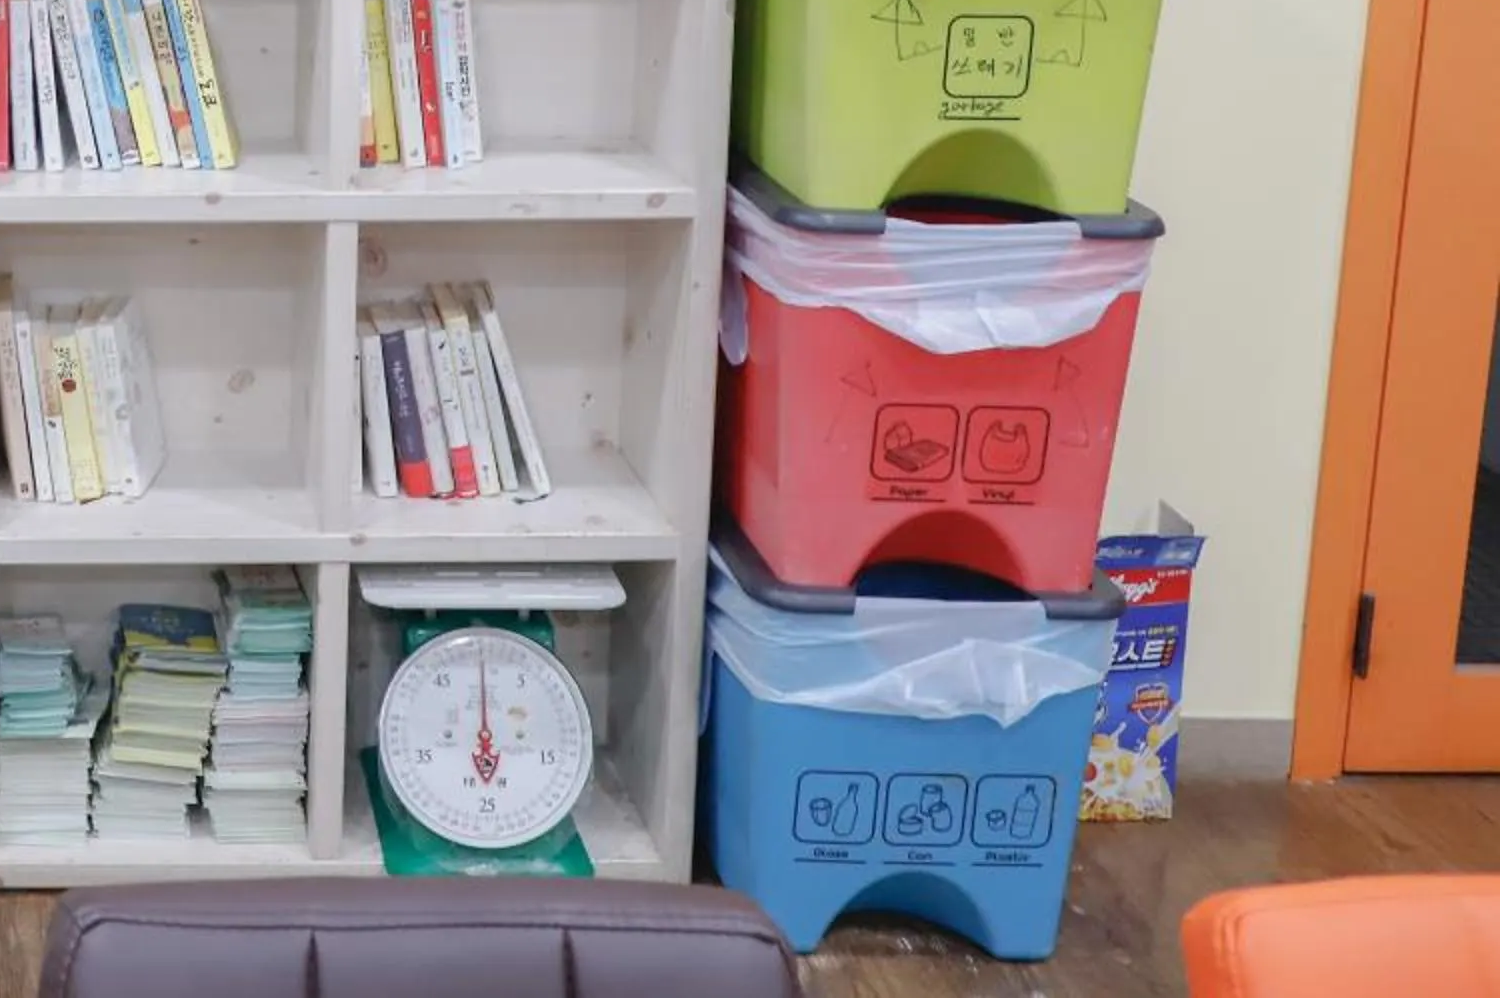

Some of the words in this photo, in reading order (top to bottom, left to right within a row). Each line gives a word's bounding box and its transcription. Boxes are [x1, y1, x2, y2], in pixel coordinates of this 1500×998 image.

[951, 54, 1023, 78] 쓰레기
[889, 486, 929, 501] Paper
[982, 488, 1015, 501] Vinyl
[434, 673, 451, 688] 45
[516, 673, 525, 689] 5
[415, 749, 433, 763] 35
[541, 749, 555, 765] 15
[479, 796, 496, 813] 25
[908, 852, 933, 861] Can
